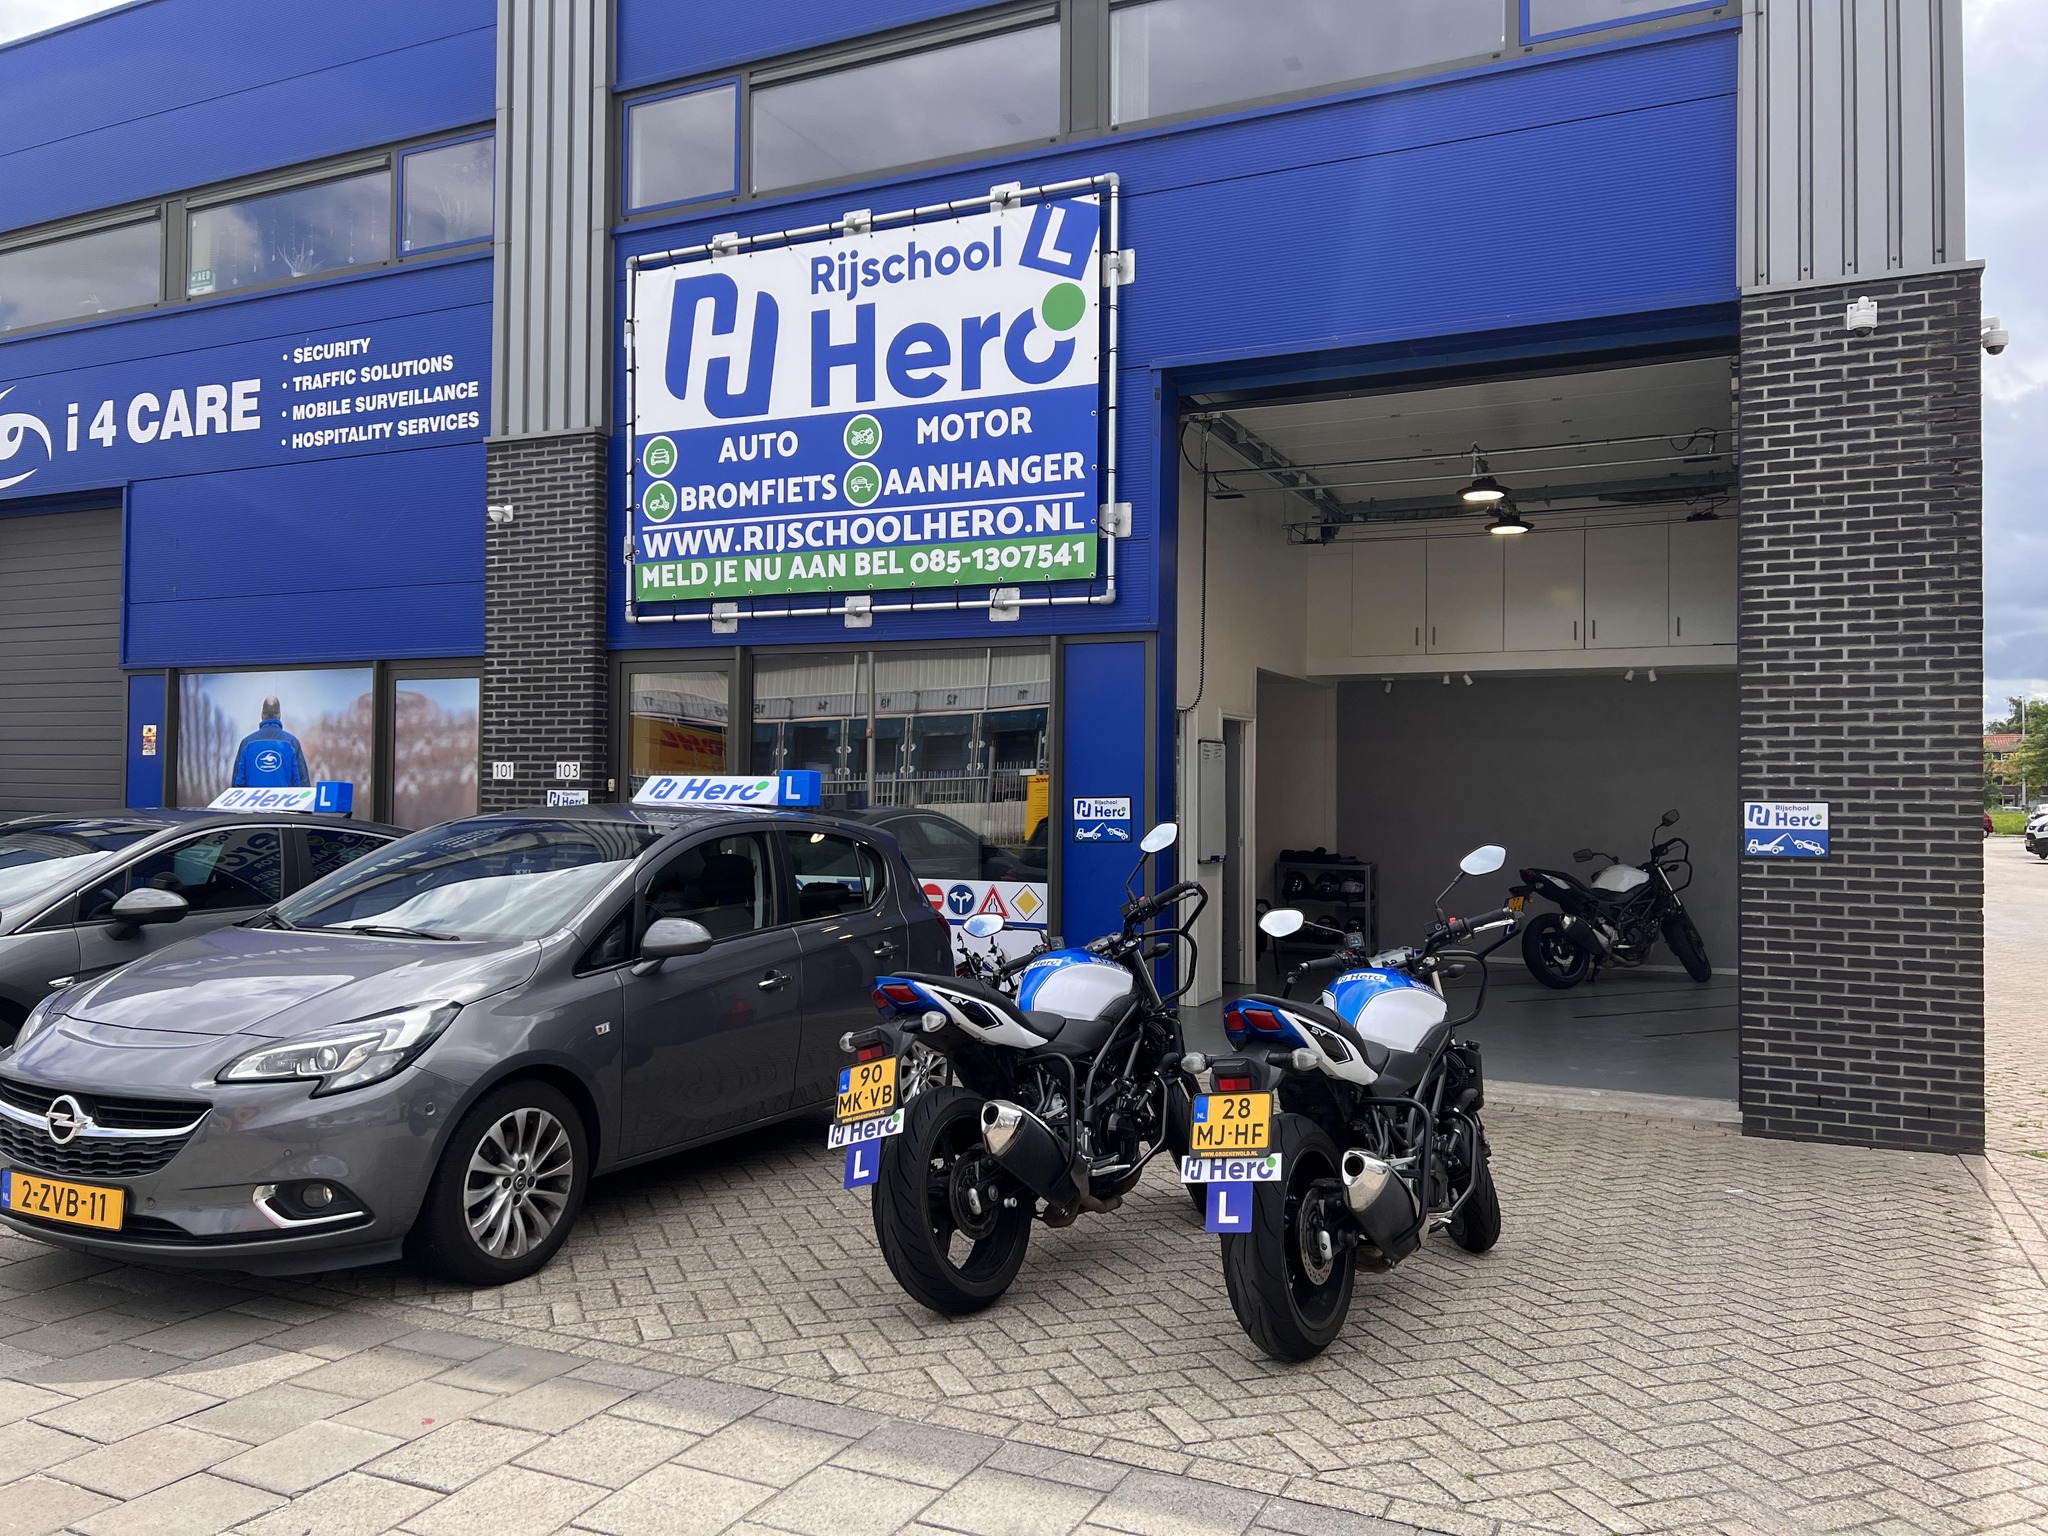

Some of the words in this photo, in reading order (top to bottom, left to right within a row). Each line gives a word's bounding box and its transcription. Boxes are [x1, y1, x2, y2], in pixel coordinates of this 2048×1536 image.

[810, 225, 1001, 300] Rijschool
[293, 338, 371, 364] SECURITY
[810, 282, 1086, 408] Hero
[293, 369, 357, 391] TRAFFIC
[360, 355, 454, 383] SOLUTIONS
[66, 403, 79, 452] i
[88, 400, 117, 447] 4
[127, 378, 261, 444] CARE
[292, 398, 351, 420] MOBILE
[355, 382, 479, 412] SURVEILLANCE
[292, 422, 393, 449] HOSPITALITY
[397, 411, 480, 435] SERVICES
[917, 406, 1033, 445] MOTOR
[718, 430, 799, 463] AUTO
[883, 451, 1085, 496] AANHANGER
[680, 473, 836, 512] BROMFIETS
[643, 501, 1085, 559] WWW.RIJSCHOOLHERO.NL
[642, 560, 708, 589] MELD
[713, 558, 738, 587] JE
[744, 556, 781, 583] NU
[788, 552, 840, 581] AAN
[855, 550, 904, 577] BEL
[910, 541, 1086, 574] 085-1307541
[495, 764, 513, 778] 101
[557, 764, 579, 778] 103
[320, 786, 331, 807] L
[677, 778, 770, 801] Hero
[785, 776, 801, 800] L
[1095, 806, 1126, 817] Hero
[1776, 813, 1822, 826] Hero
[949, 996, 969, 1006] SV
[1311, 1027, 1327, 1037] SV
[861, 1064, 882, 1087] 90
[838, 1085, 892, 1115] MK-VB
[1222, 1098, 1251, 1119] 28
[850, 1113, 900, 1142] Hero
[1197, 1123, 1263, 1146] MJ-HF
[854, 1150, 869, 1180] L
[1210, 1157, 1276, 1179] Hero
[2, 1192, 9, 1201] NL
[21, 1180, 107, 1222] 2-ZVB-11
[1218, 1191, 1239, 1223] L
